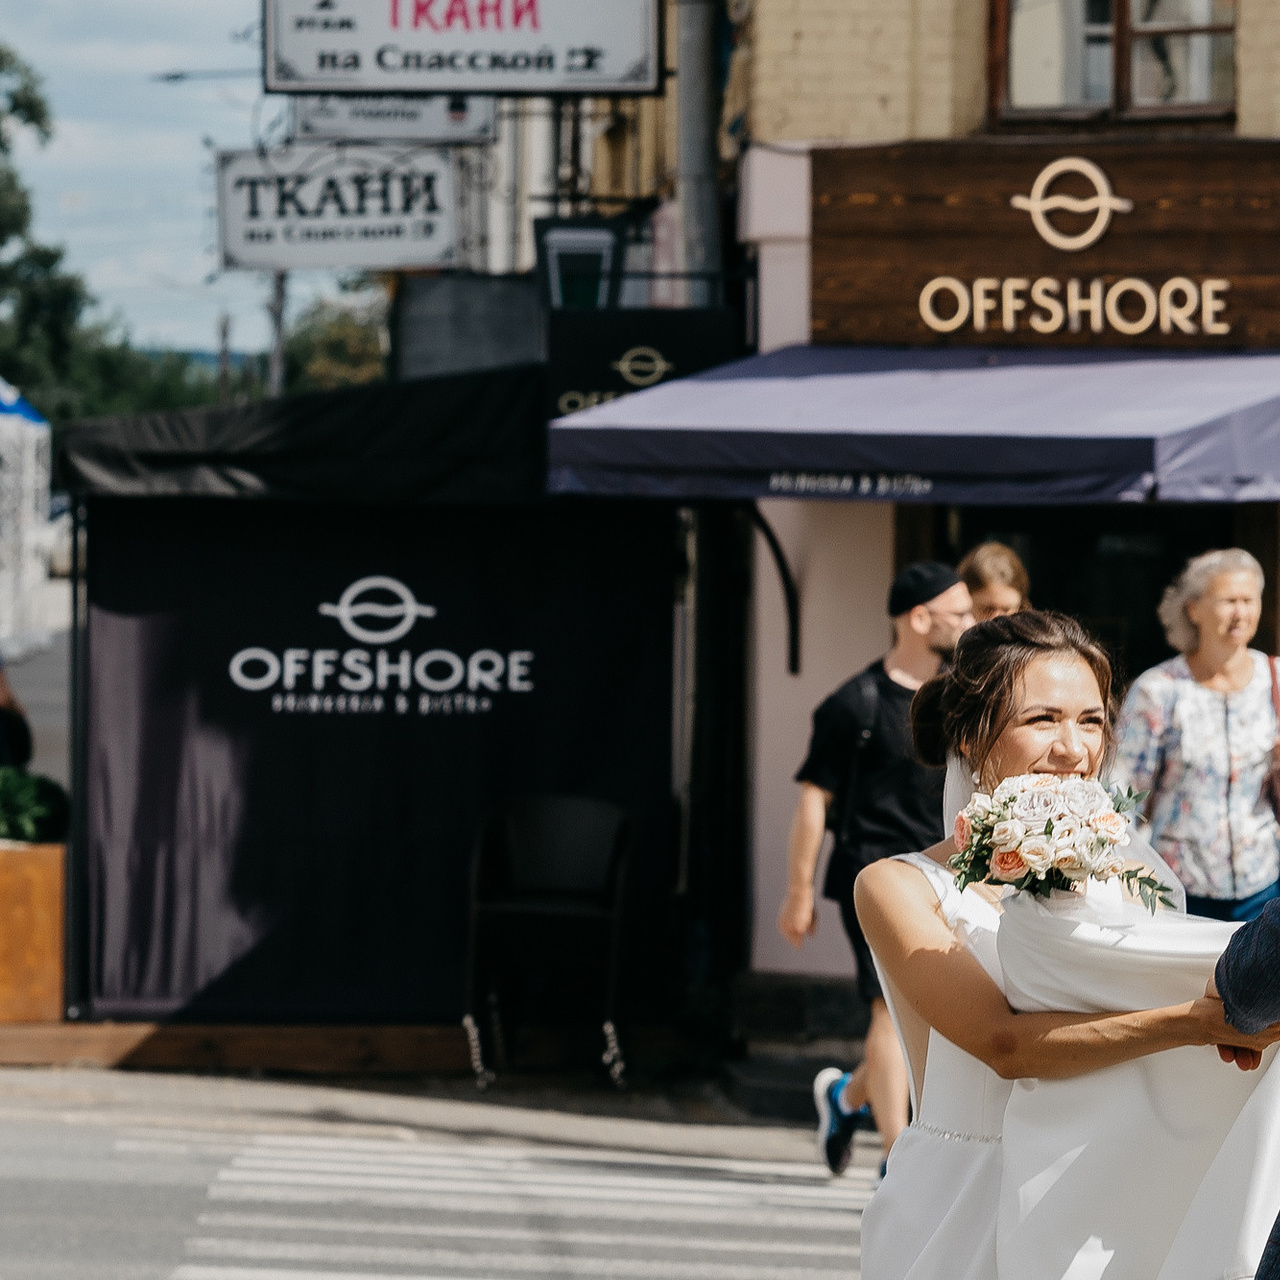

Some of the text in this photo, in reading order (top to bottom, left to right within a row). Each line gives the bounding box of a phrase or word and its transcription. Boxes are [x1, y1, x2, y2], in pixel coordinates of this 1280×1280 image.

[317, 44, 555, 72] на Спасской
[235, 171, 439, 218] ТКАНИ
[918, 276, 1232, 336] OFFSHORE
[228, 647, 535, 692] OFFSHORE
